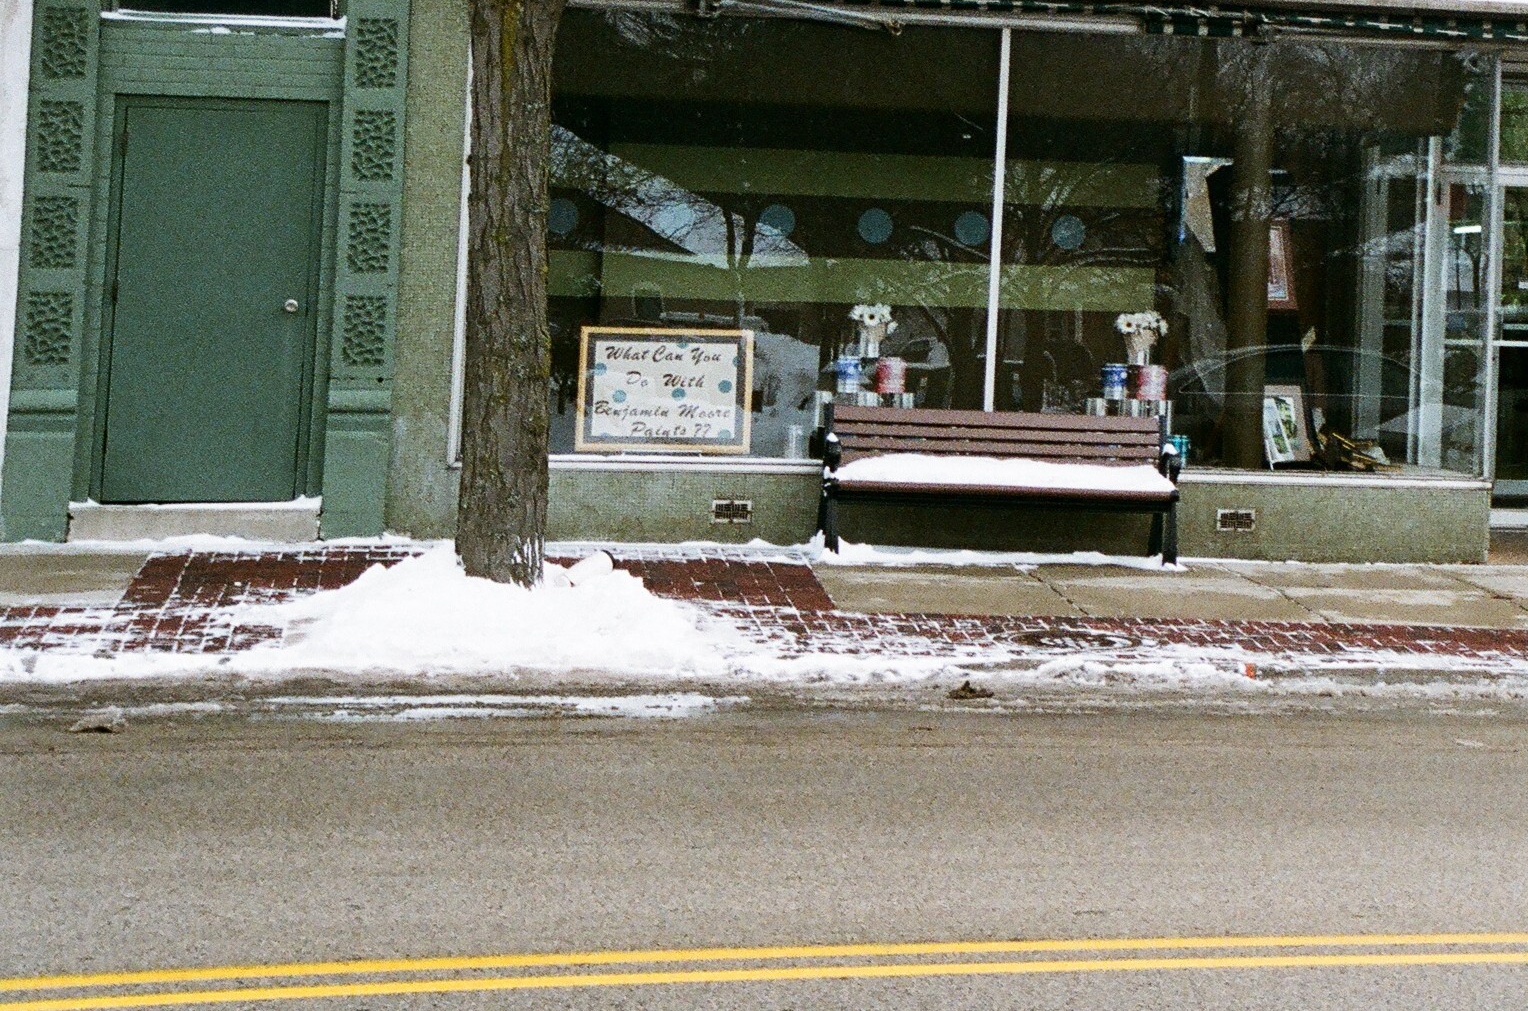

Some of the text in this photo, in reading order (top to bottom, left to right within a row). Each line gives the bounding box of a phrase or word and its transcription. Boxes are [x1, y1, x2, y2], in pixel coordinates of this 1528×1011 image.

[605, 345, 722, 366] What Can You
[626, 370, 706, 388] Do With
[594, 400, 731, 421] Benjamin Moore
[630, 421, 687, 437] Paints
